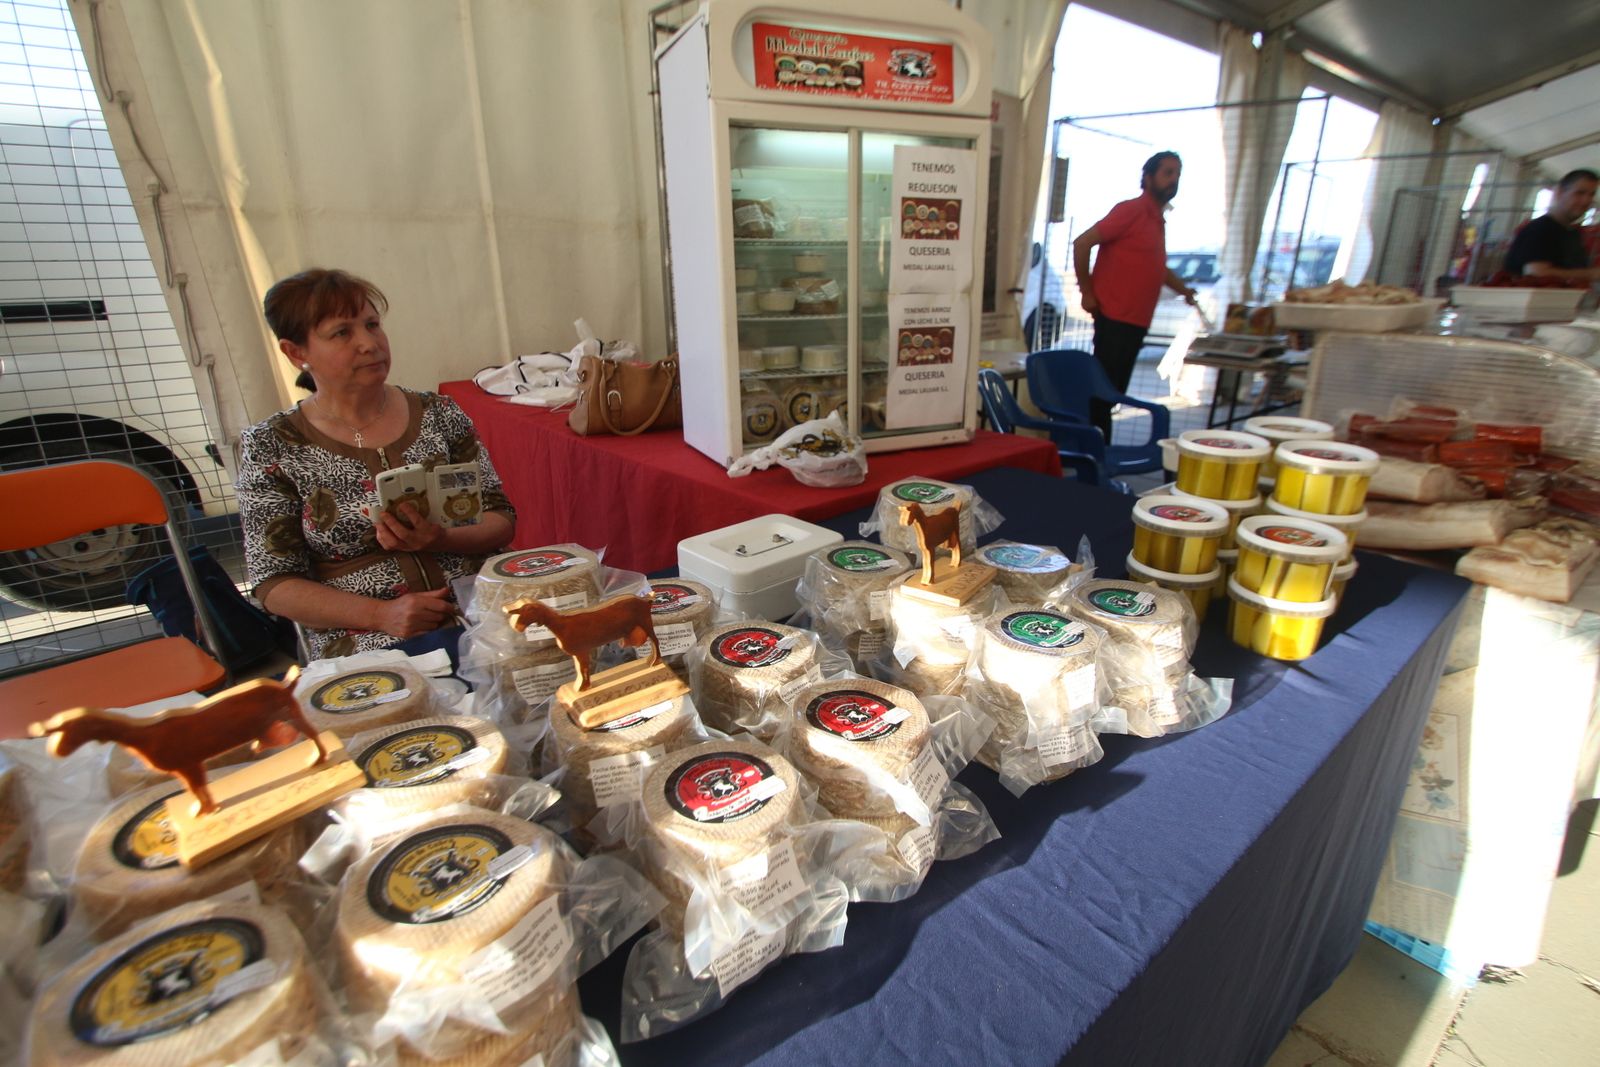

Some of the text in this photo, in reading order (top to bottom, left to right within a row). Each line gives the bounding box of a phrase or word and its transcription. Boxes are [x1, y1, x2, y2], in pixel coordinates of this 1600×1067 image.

[911, 162, 956, 174] TENEMOS
[908, 182, 958, 193] REQUESON
[908, 246, 951, 257] QUESERIA
[904, 370, 945, 382] QUESERIA
